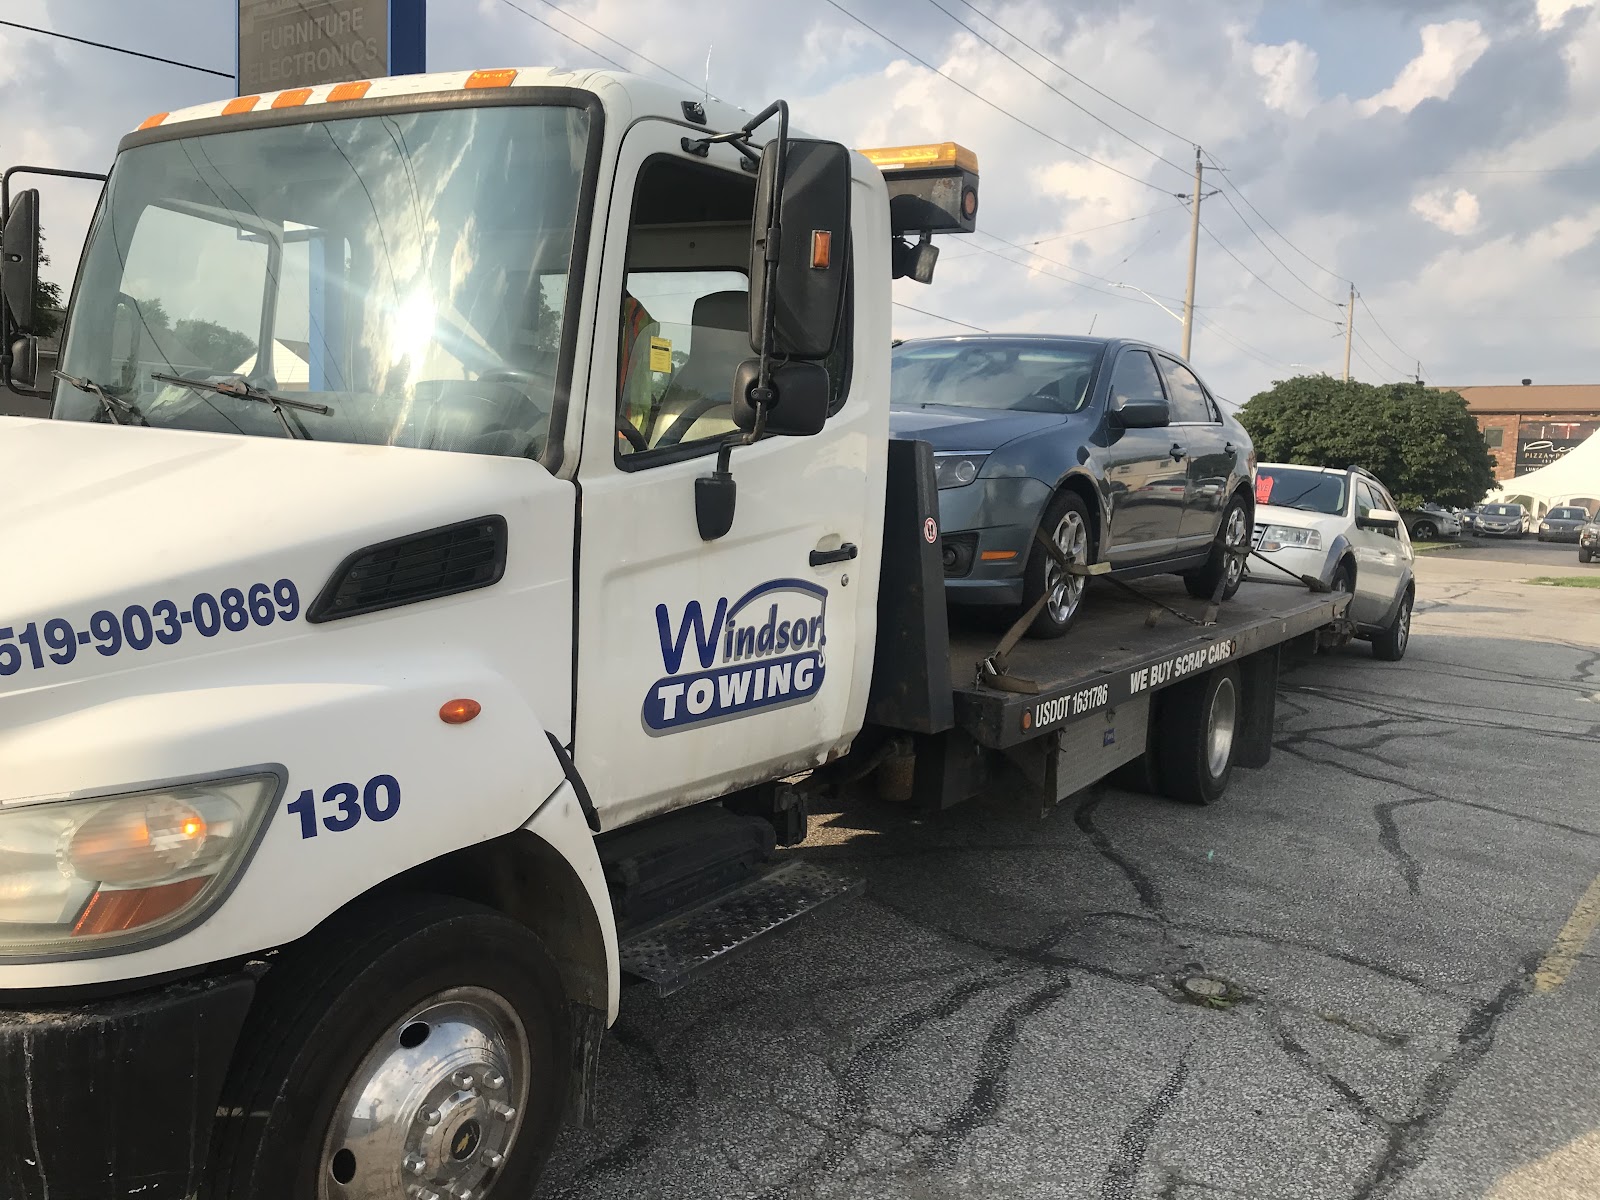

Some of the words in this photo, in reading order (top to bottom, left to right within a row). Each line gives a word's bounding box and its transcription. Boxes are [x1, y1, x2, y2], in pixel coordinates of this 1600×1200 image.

[261, 7, 364, 52] FURNITURE
[249, 37, 378, 84] ELECTRONICS
[0, 578, 300, 676] 519-903-0869
[655, 597, 823, 674] Windsor
[657, 658, 815, 721] TOWING
[1130, 668, 1149, 694] WE
[1150, 659, 1175, 685] BUY
[1174, 649, 1206, 678] SCRAP
[1208, 639, 1231, 665] CARS
[1035, 694, 1071, 728] USDOT
[1072, 683, 1109, 715] 1631786
[287, 774, 401, 839] 130
